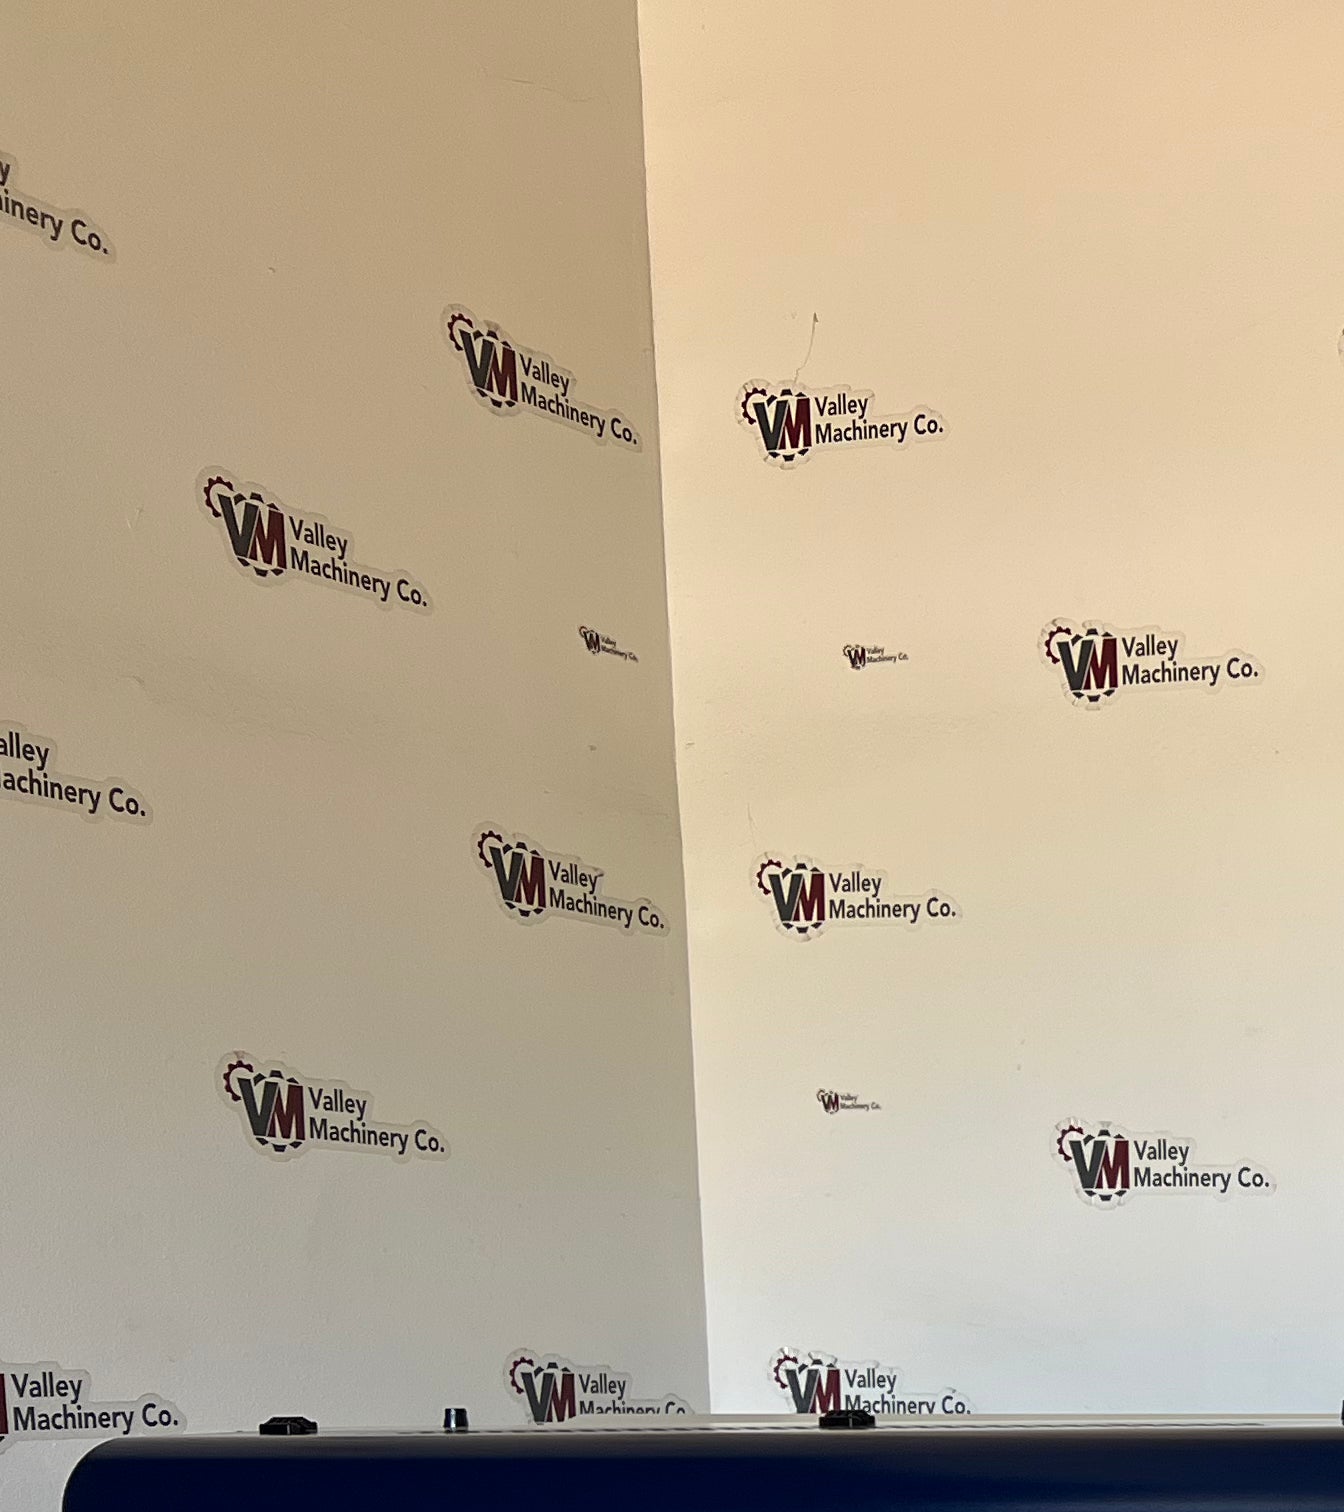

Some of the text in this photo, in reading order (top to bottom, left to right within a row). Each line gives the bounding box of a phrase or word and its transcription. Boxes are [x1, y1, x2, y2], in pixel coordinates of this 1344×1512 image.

[71, 219, 109, 254] Co.
[458, 329, 518, 404] VM
[519, 353, 569, 397] Valley
[521, 381, 637, 445] Machinery Co.
[814, 393, 868, 420] Valley
[752, 402, 812, 451] VM
[815, 414, 943, 444] Machinery Co.
[217, 492, 287, 575] VM
[288, 516, 348, 560] Valley
[290, 546, 427, 607] Machinery Co.
[1056, 637, 1118, 690] VM
[1122, 634, 1178, 661] Valley
[1122, 657, 1258, 686] Machinery Co.
[0, 768, 146, 816] achinery Co.
[488, 845, 546, 908] VM
[548, 860, 597, 891] Valley
[829, 871, 882, 898] Valley
[549, 886, 664, 929] Machinery Co.
[768, 873, 825, 922] VM
[829, 897, 956, 924] Machinery Co.
[237, 1078, 306, 1141] VM
[308, 1087, 367, 1122] Valley
[309, 1117, 444, 1155] Machinery Co.
[1133, 1139, 1189, 1167] Valley
[1069, 1140, 1130, 1190] VM
[1134, 1165, 1269, 1193] Machinery Co.
[10, 1371, 83, 1404] Valley
[520, 1371, 576, 1423] VM
[578, 1373, 626, 1400] Valley
[785, 1369, 841, 1414] VM
[844, 1368, 896, 1394] Valley
[13, 1403, 178, 1435] Machinery Co.
[665, 1401, 685, 1414] Co
[942, 1395, 971, 1415] Co.
